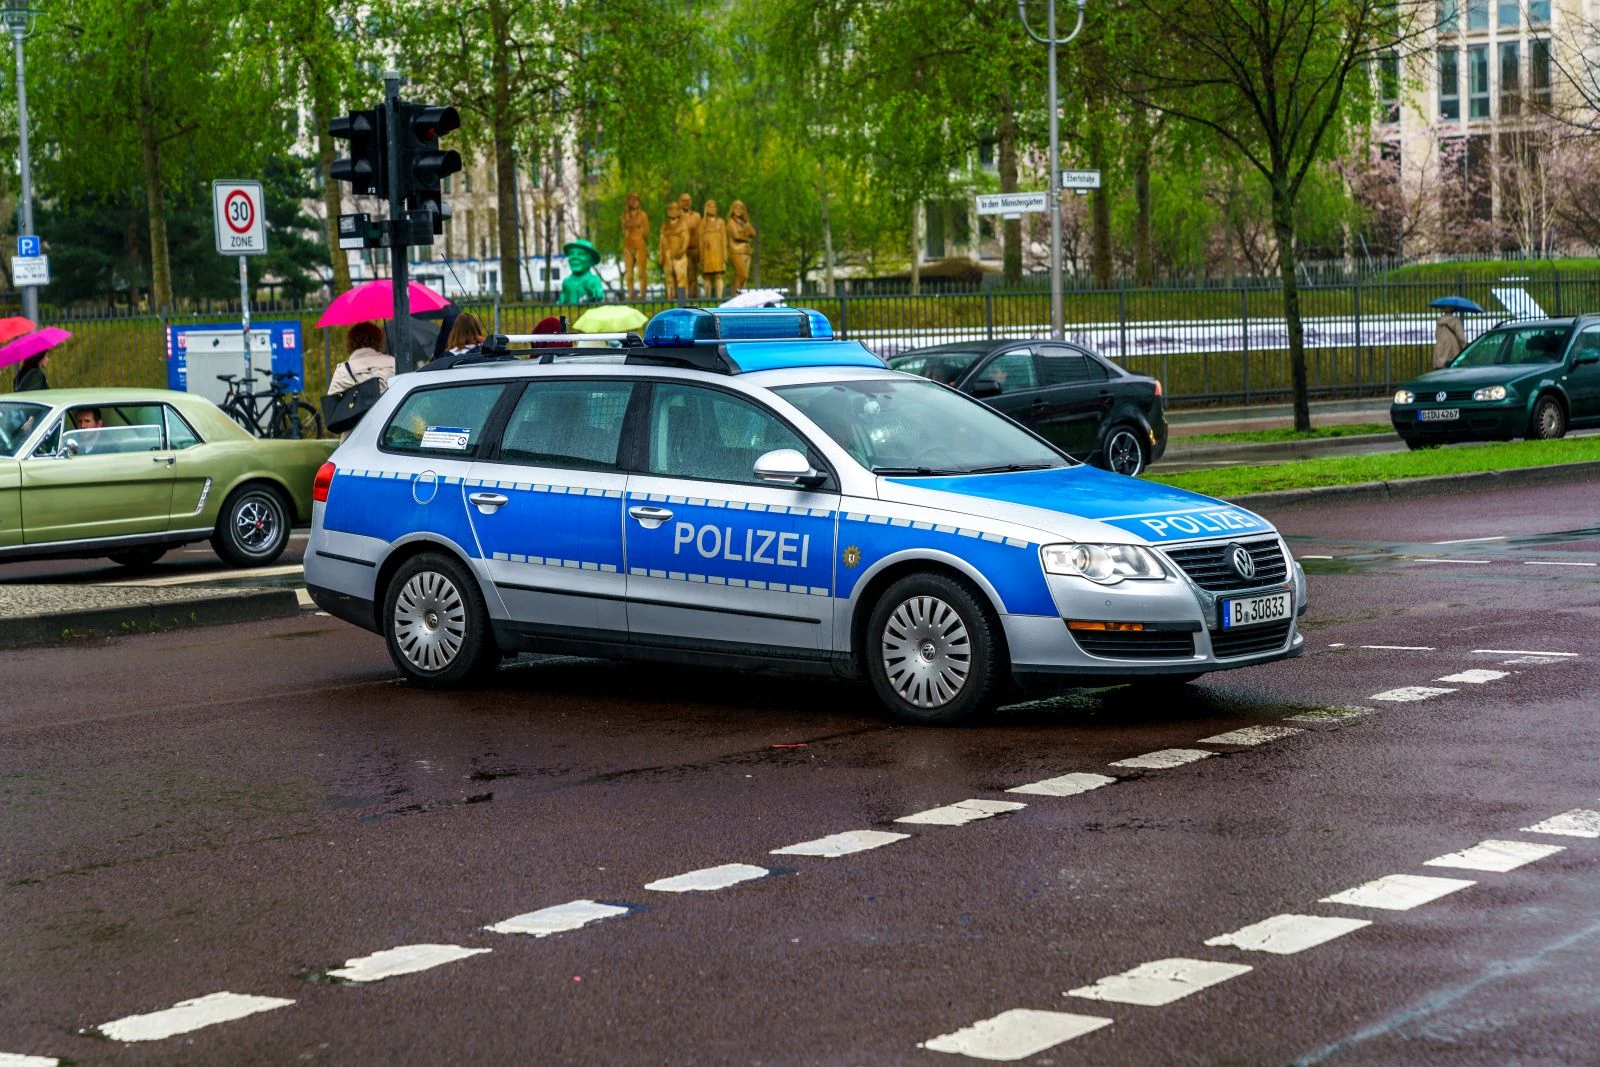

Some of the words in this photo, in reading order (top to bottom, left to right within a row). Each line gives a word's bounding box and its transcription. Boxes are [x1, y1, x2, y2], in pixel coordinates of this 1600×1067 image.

[231, 201, 248, 221] 30
[981, 200, 987, 208] In
[988, 200, 999, 208] den
[21, 239, 33, 255] P
[230, 236, 253, 247] ZONE
[1141, 510, 1260, 537] POLIZEI
[674, 521, 810, 568] POLIZEI
[1235, 602, 1243, 622] B
[1251, 596, 1284, 619] 30833
